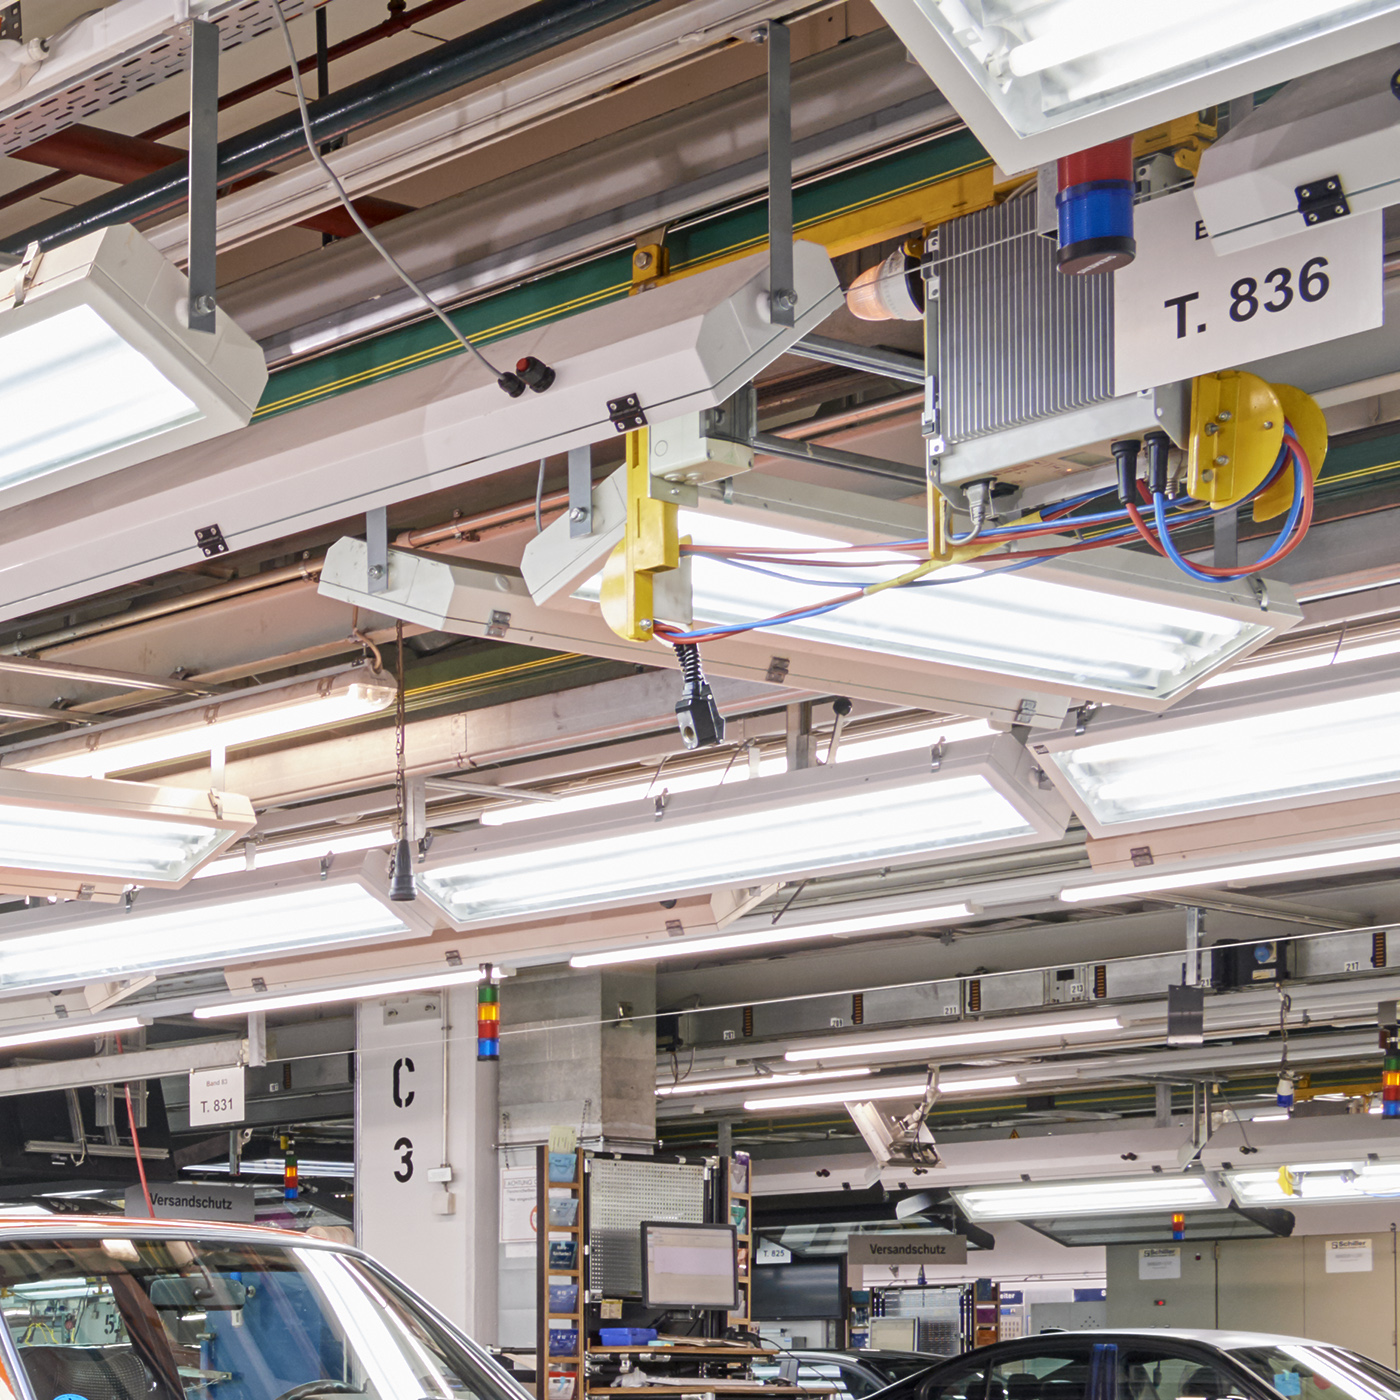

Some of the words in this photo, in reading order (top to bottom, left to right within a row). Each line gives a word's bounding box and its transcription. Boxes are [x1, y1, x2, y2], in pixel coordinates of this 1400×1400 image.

[1164, 291, 1207, 340] T.
[1229, 256, 1331, 323] 836
[1346, 961, 1359, 971] 217
[393, 1057, 415, 1108] C
[201, 1101, 210, 1113] T.
[213, 1098, 233, 1112] 831
[393, 1137, 414, 1183] 3
[150, 1193, 233, 1210] Versandschutz
[763, 1250, 769, 1258] T.
[870, 1243, 946, 1255] Versandschutz
